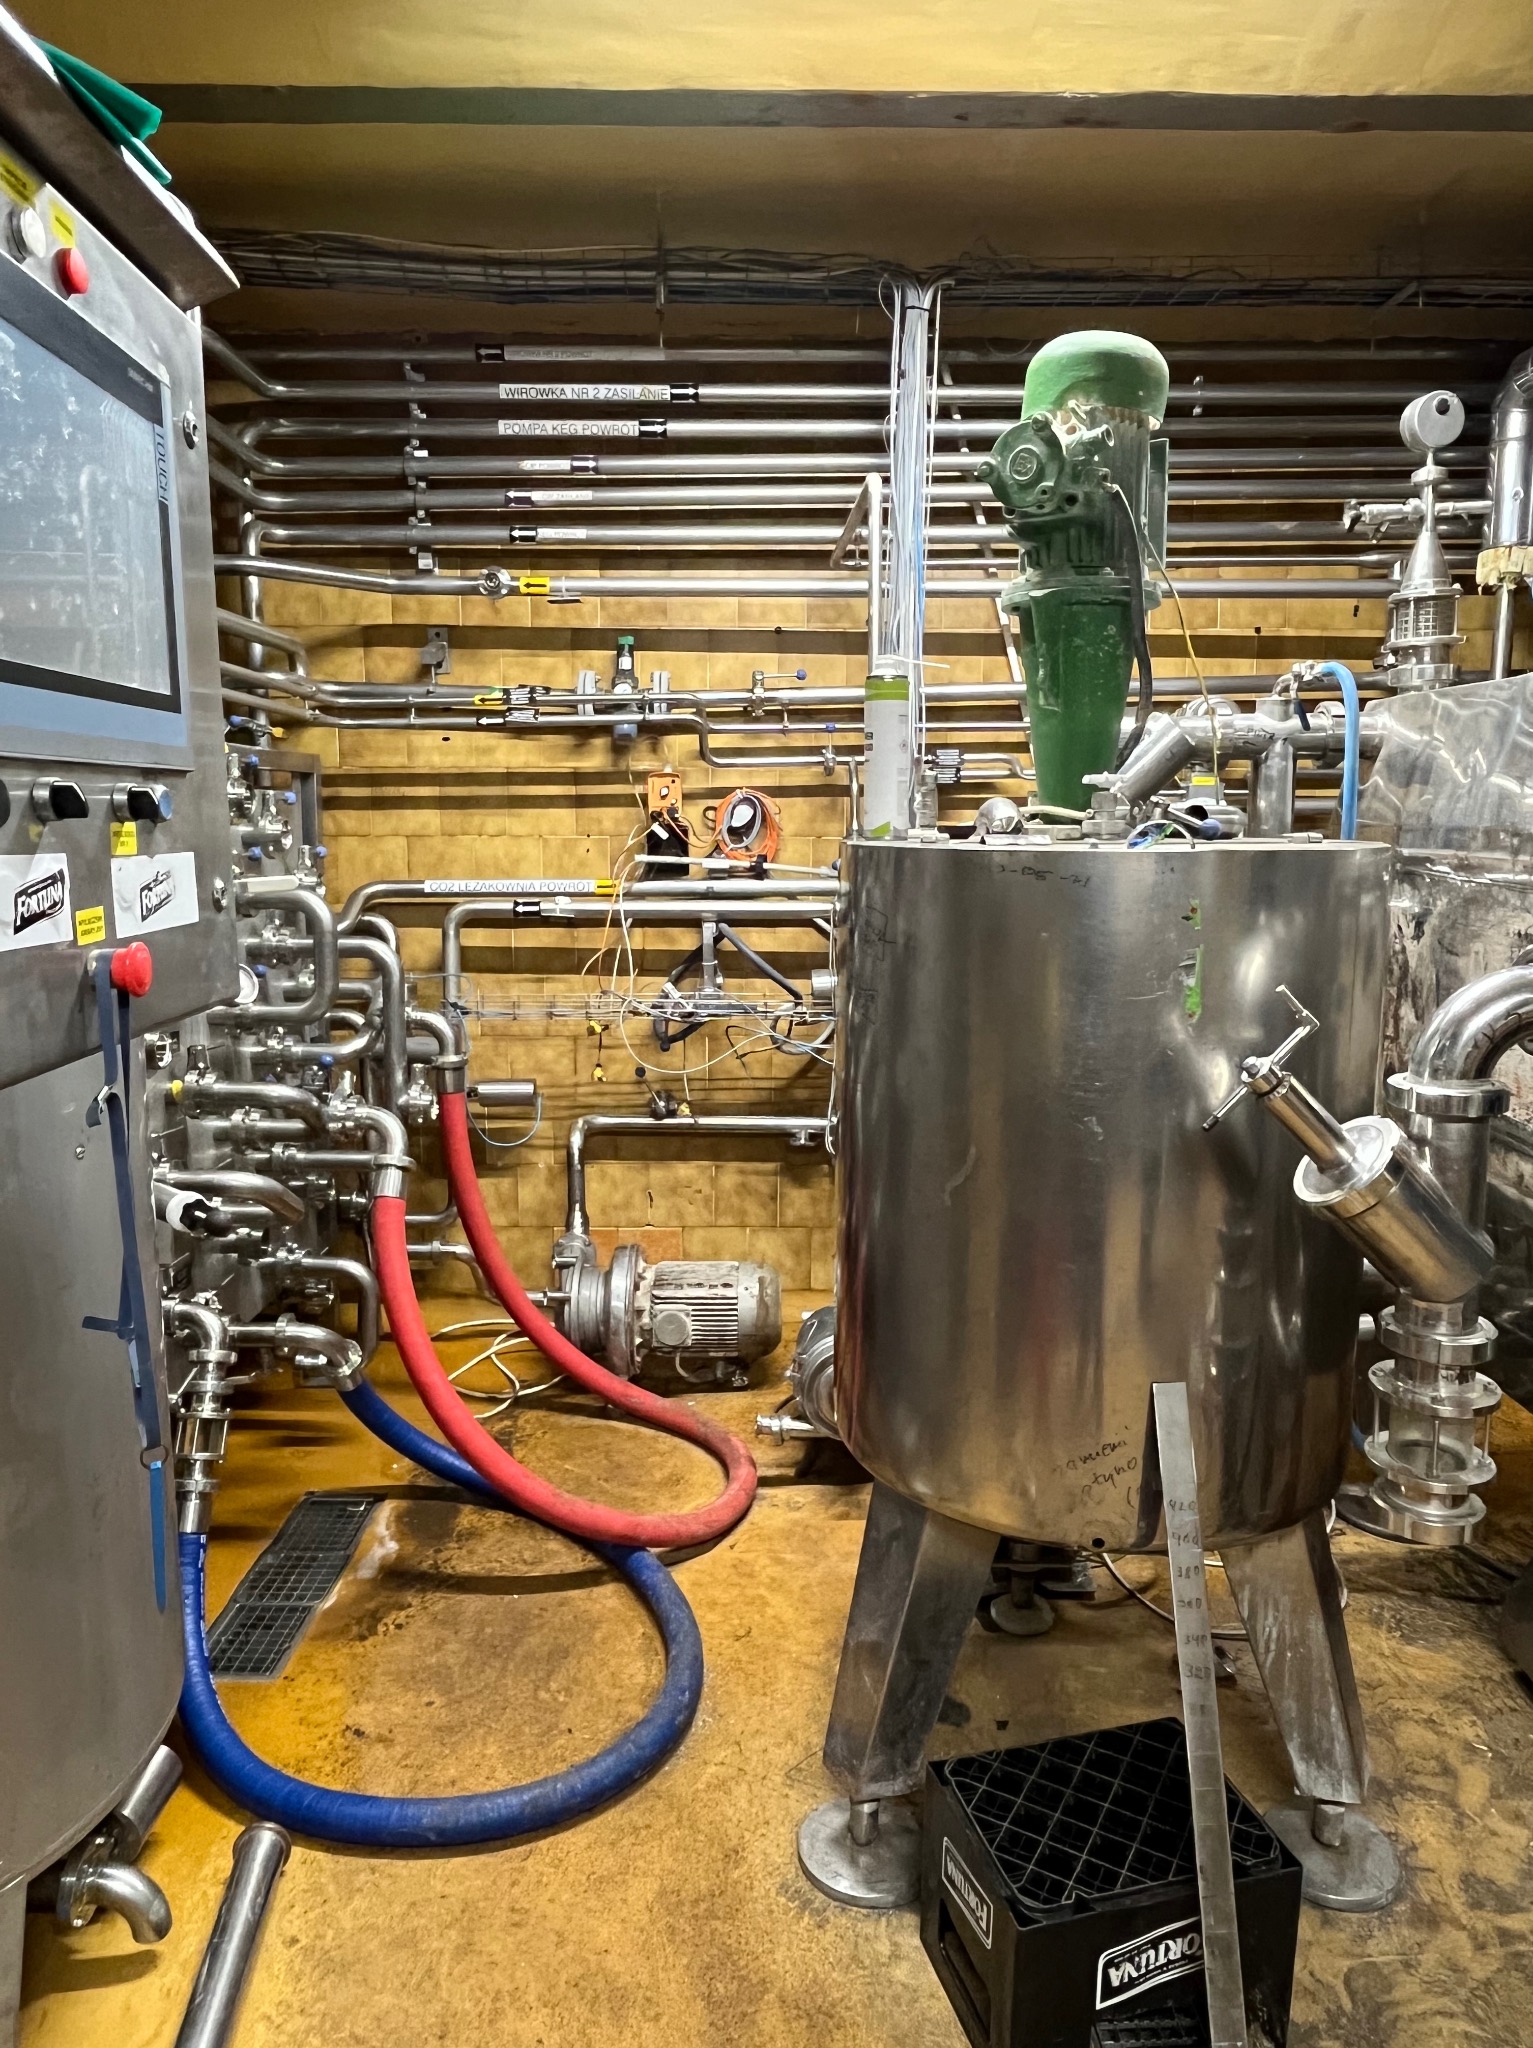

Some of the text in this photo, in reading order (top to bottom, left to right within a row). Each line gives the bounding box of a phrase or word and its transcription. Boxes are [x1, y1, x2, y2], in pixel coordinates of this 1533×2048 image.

[571, 387, 590, 399] NR
[593, 387, 600, 399] 2
[603, 387, 669, 400] ZASILANIE
[503, 422, 548, 435] POMPA
[552, 422, 578, 436] KEG
[155, 432, 169, 502] TOUCH
[429, 881, 455, 892] CO2
[1107, 1932, 1205, 1988] ORTUNA
